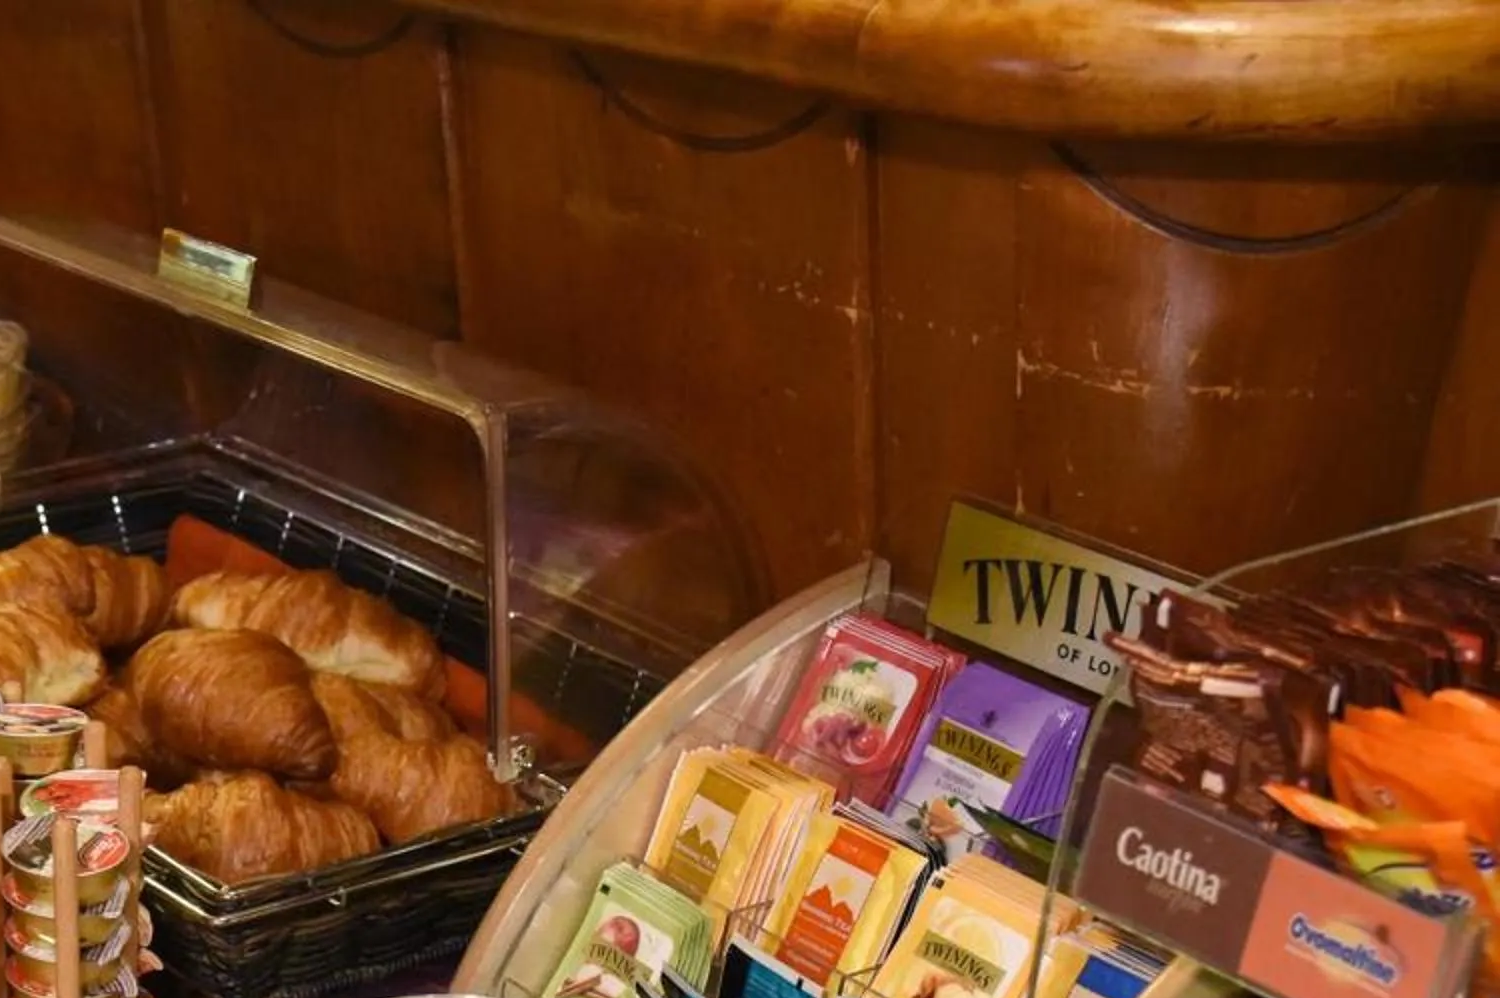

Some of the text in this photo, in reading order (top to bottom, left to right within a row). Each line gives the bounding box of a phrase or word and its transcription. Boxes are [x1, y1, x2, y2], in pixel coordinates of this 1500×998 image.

[963, 559, 1160, 641] TWIN
[1056, 643, 1081, 665] OF
[935, 726, 1015, 778] TWININGS
[1116, 825, 1221, 906] Caotina
[922, 940, 997, 990] TWININGS
[1290, 914, 1396, 986] Ovomaltine
